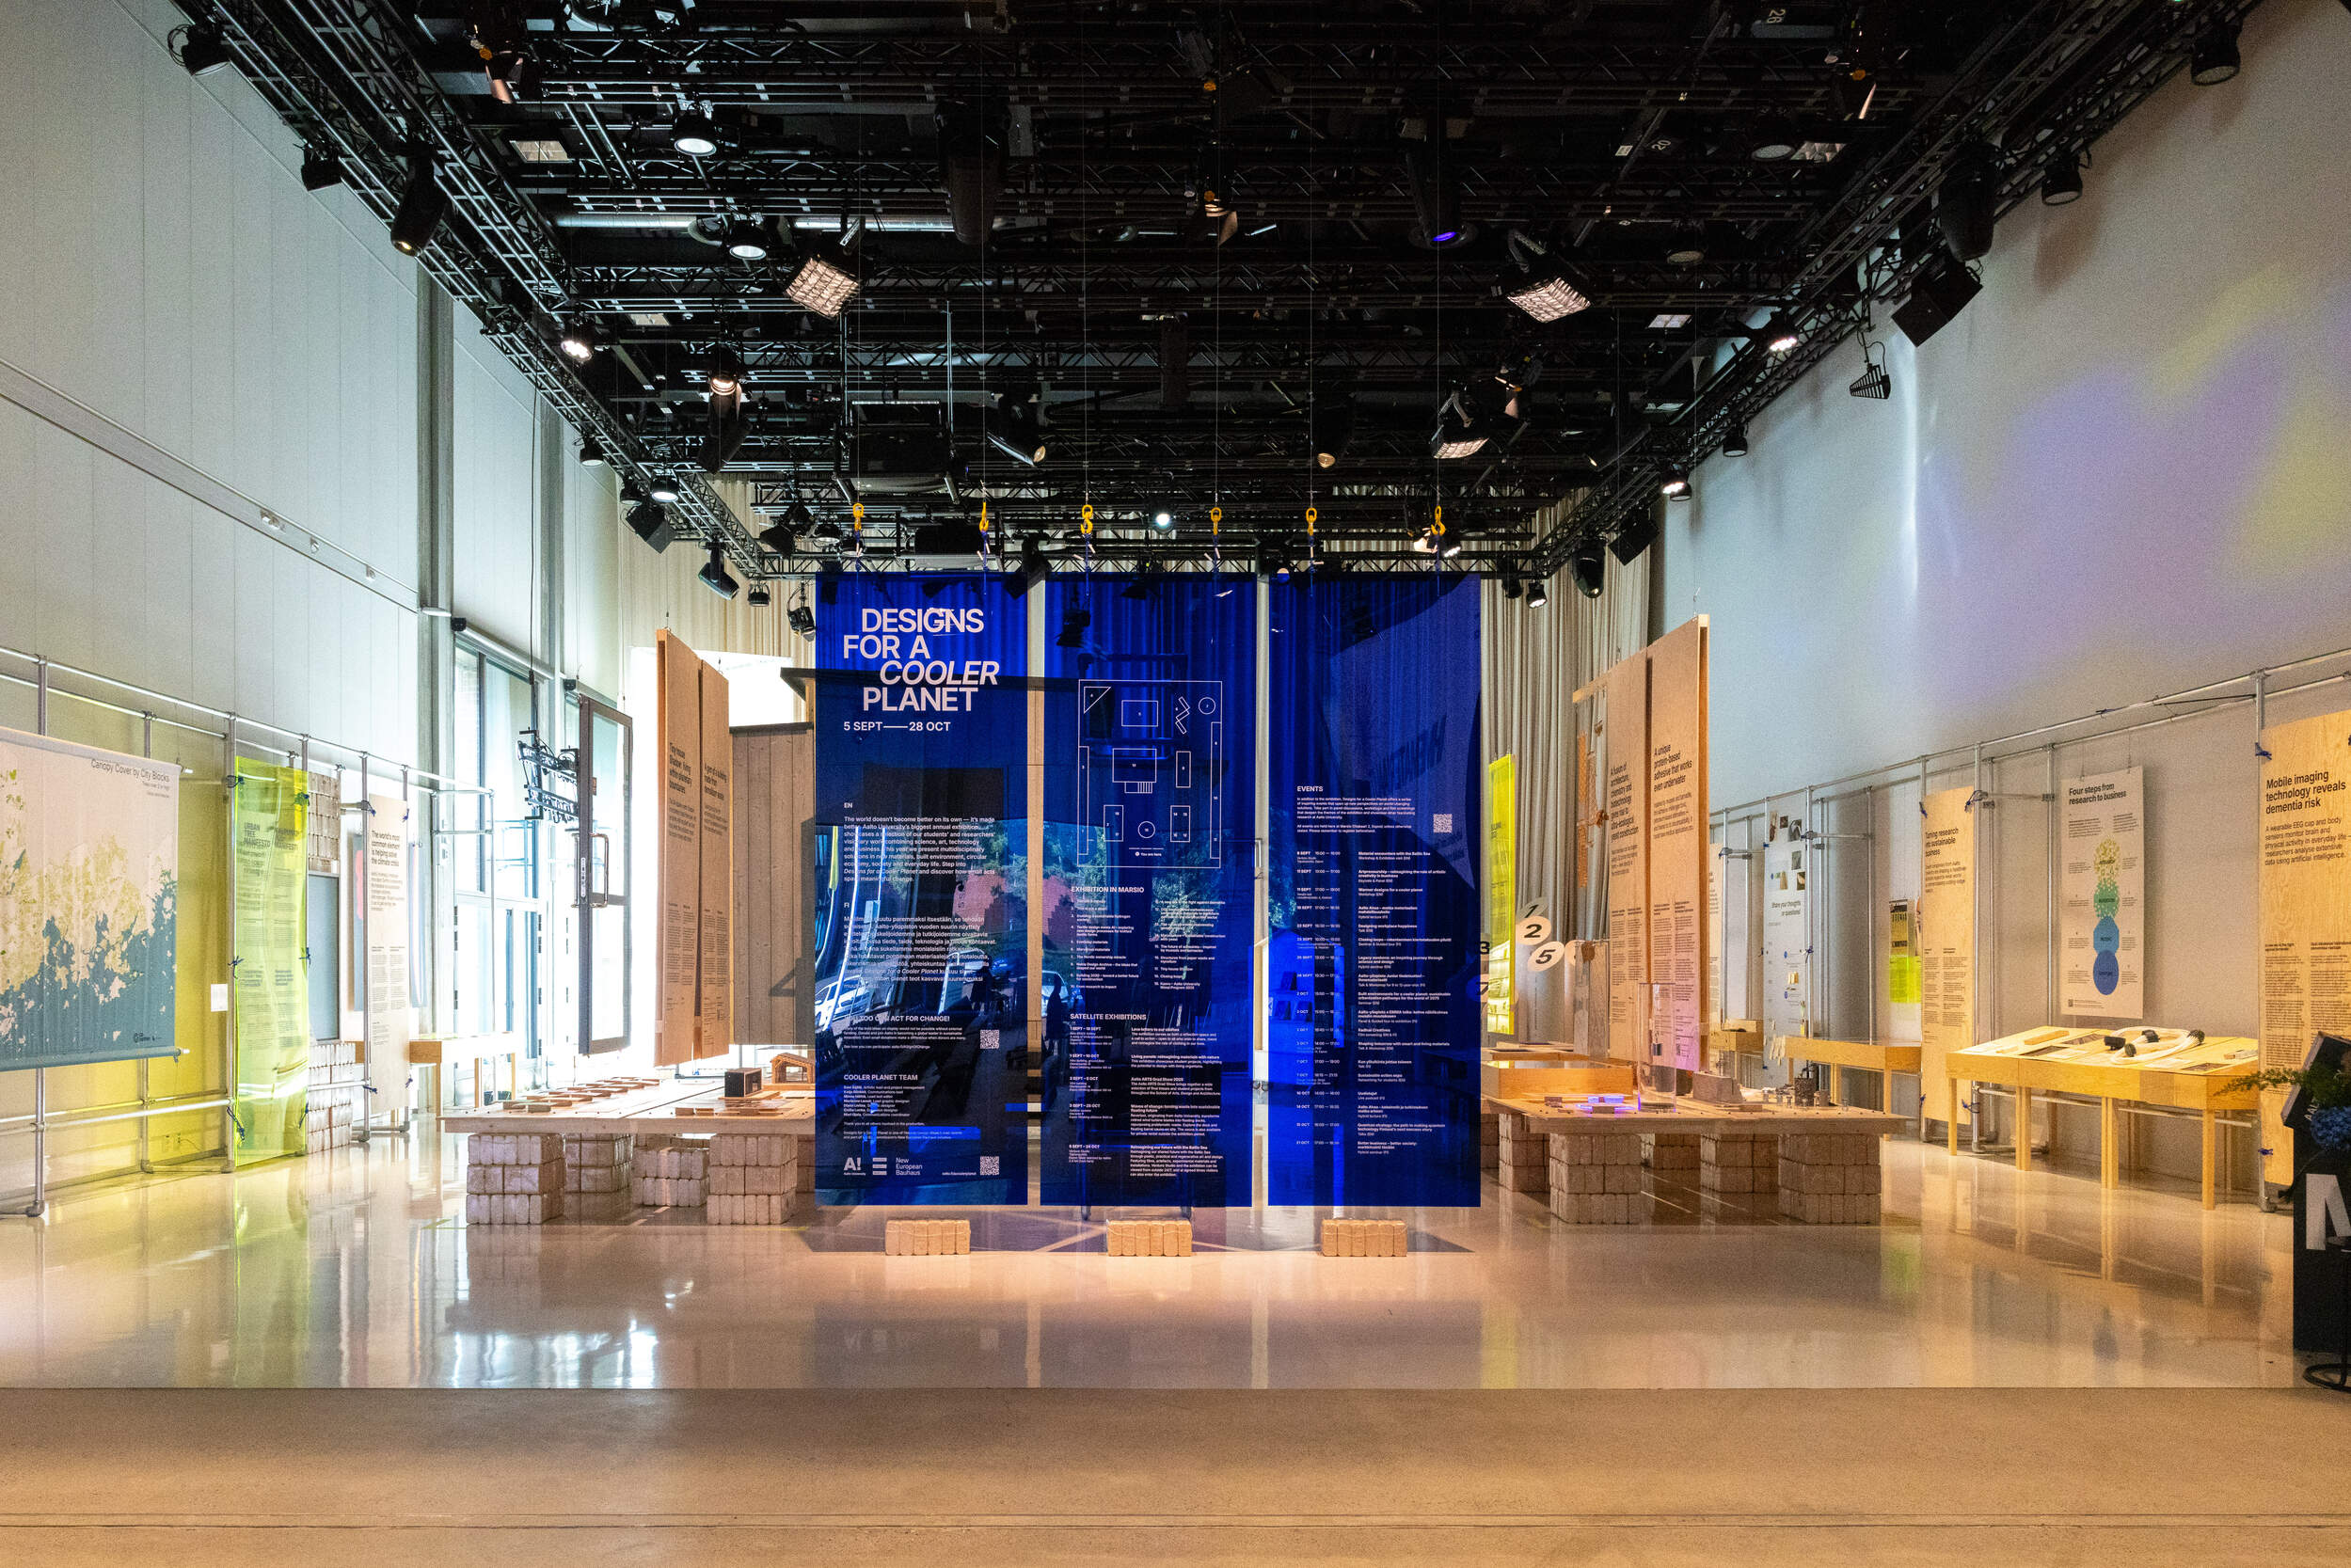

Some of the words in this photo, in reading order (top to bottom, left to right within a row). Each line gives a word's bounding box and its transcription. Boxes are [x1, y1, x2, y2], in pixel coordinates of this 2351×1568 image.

[862, 608, 984, 633] DESIGNS
[844, 635, 900, 659] FOR
[909, 635, 930, 658] A
[880, 660, 1000, 685] COOLER
[863, 687, 978, 711] PLANET
[844, 721, 850, 731] 5
[926, 721, 951, 731] OCT
[91, 758, 113, 772] Canopy
[115, 764, 132, 775] Cover
[134, 768, 139, 779] by
[1654, 751, 1681, 770] protein-based
[1654, 768, 1671, 781] adhesive
[1680, 760, 1692, 771] works
[2266, 776, 2292, 789] Mobile
[2295, 770, 2329, 784] imaging
[1663, 774, 1686, 789] underwater
[2070, 787, 2084, 796] Four
[2085, 785, 2101, 794] steps
[2266, 787, 2311, 801] technology
[2313, 780, 2346, 795] reveals
[2070, 795, 2096, 804] research
[2265, 800, 2302, 815] dementia
[2305, 797, 2321, 809] risk
[2311, 834, 2336, 845] everyday
[1524, 904, 1539, 918] 1
[1524, 924, 1542, 938] 2
[1535, 949, 1556, 964] 5
[844, 1157, 862, 1171] A!
